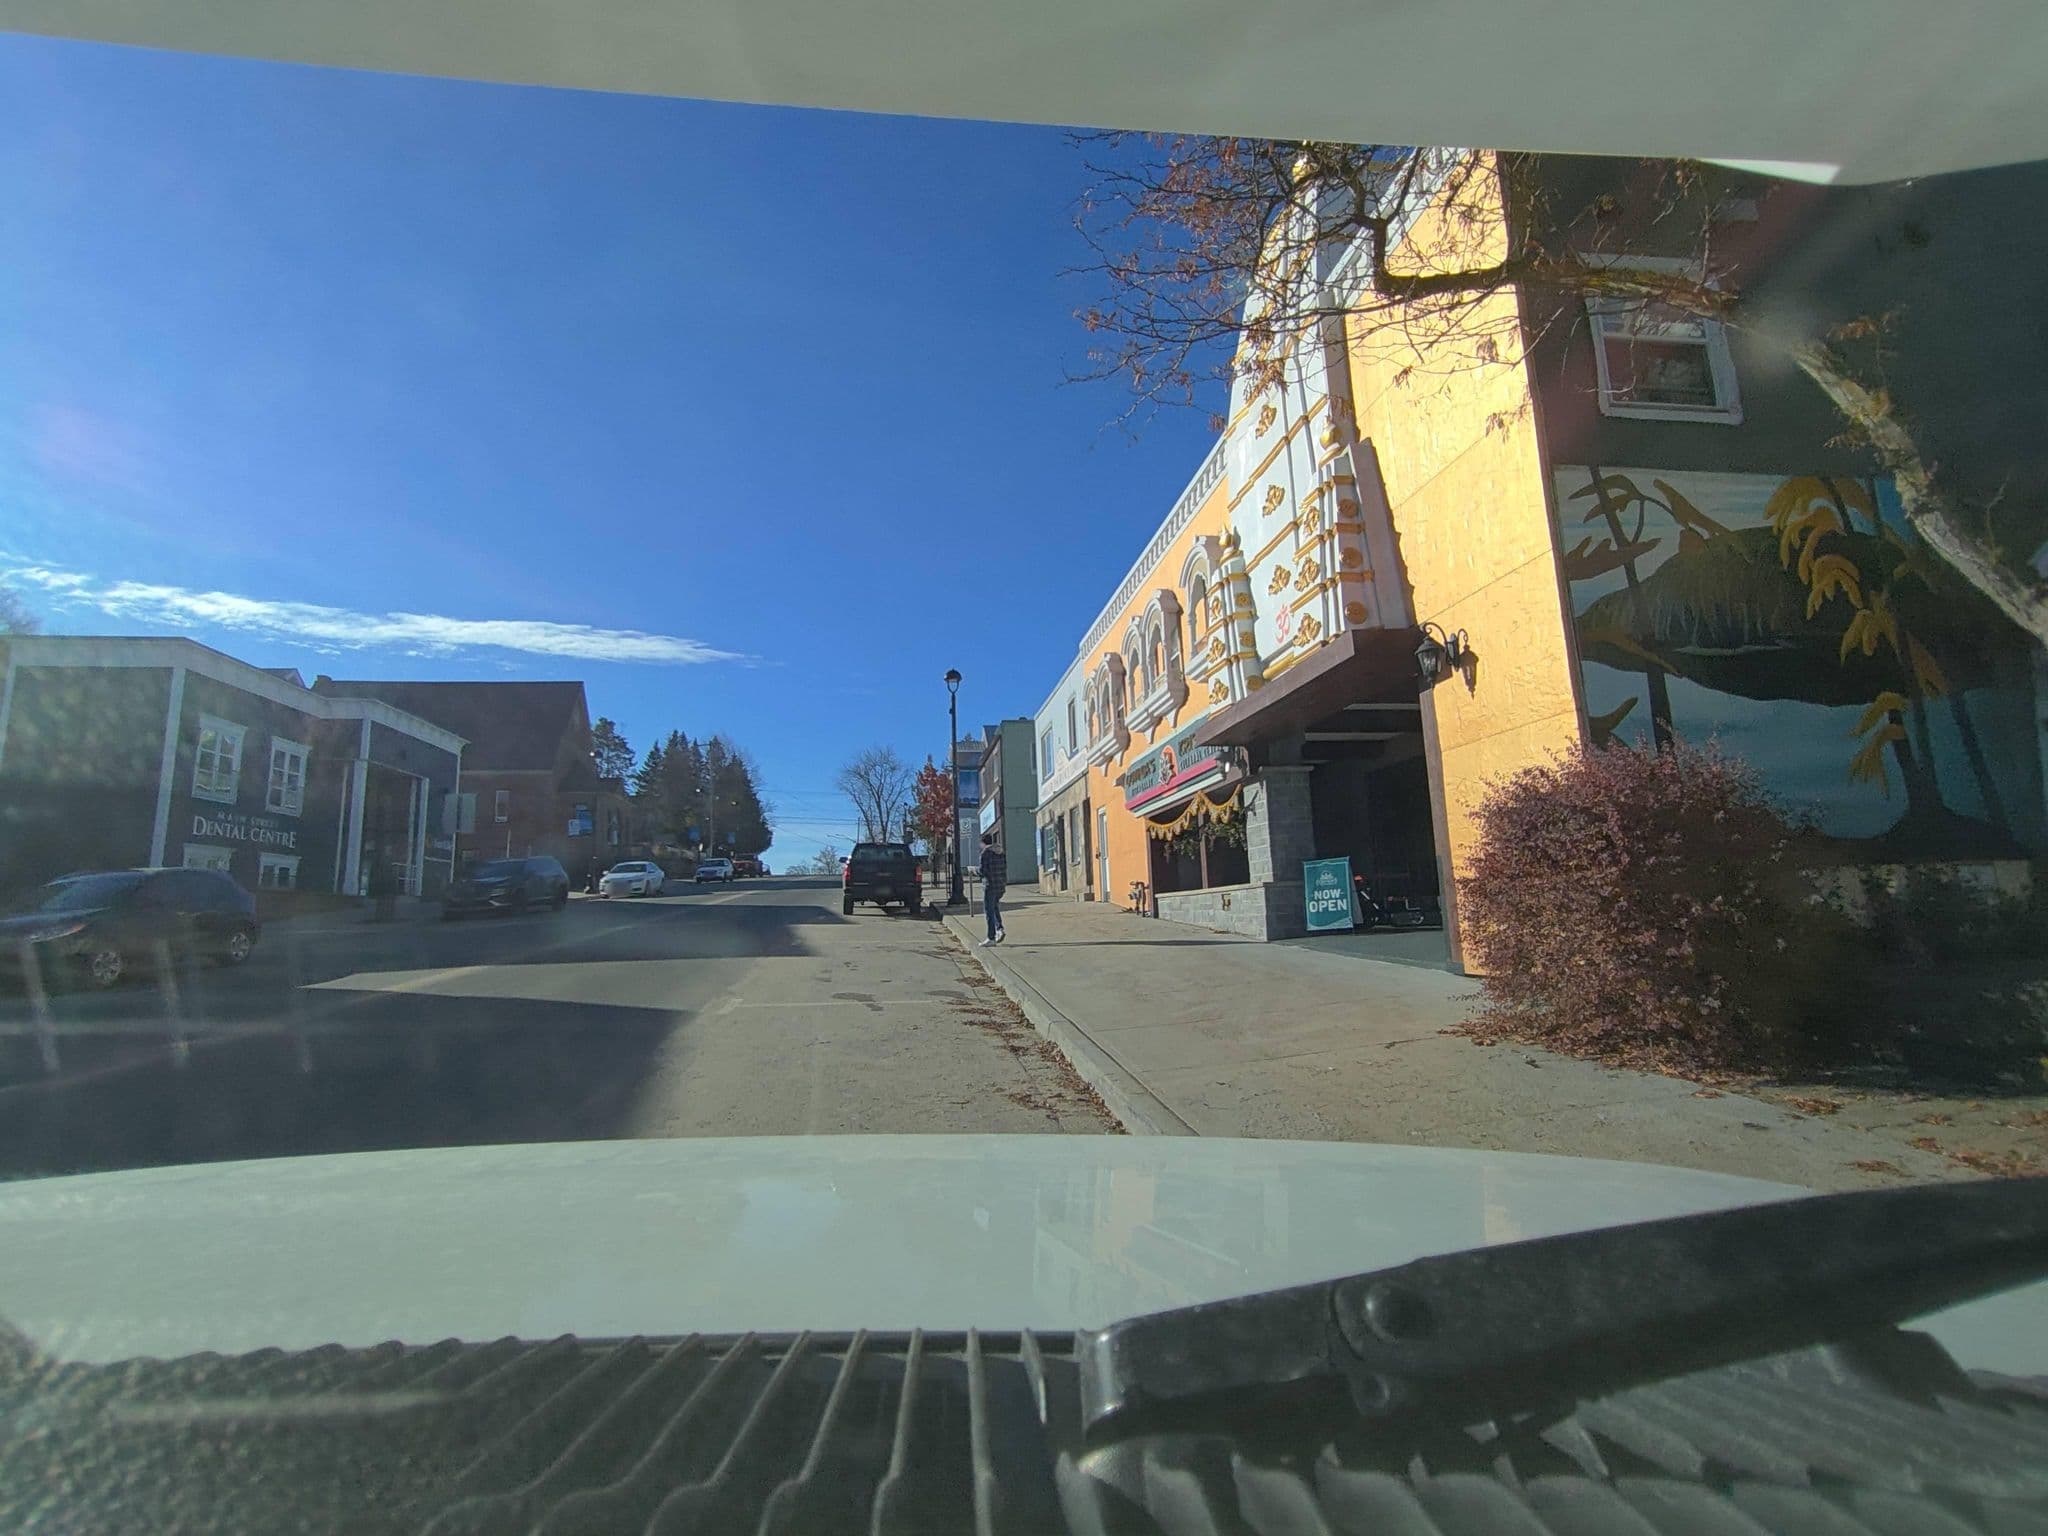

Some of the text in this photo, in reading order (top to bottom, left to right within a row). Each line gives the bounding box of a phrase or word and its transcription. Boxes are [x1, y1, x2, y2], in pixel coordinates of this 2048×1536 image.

[192, 815, 297, 848] DENTAL CENTRE
[1314, 889, 1341, 900] NOW
[1309, 899, 1347, 912] OPEN
